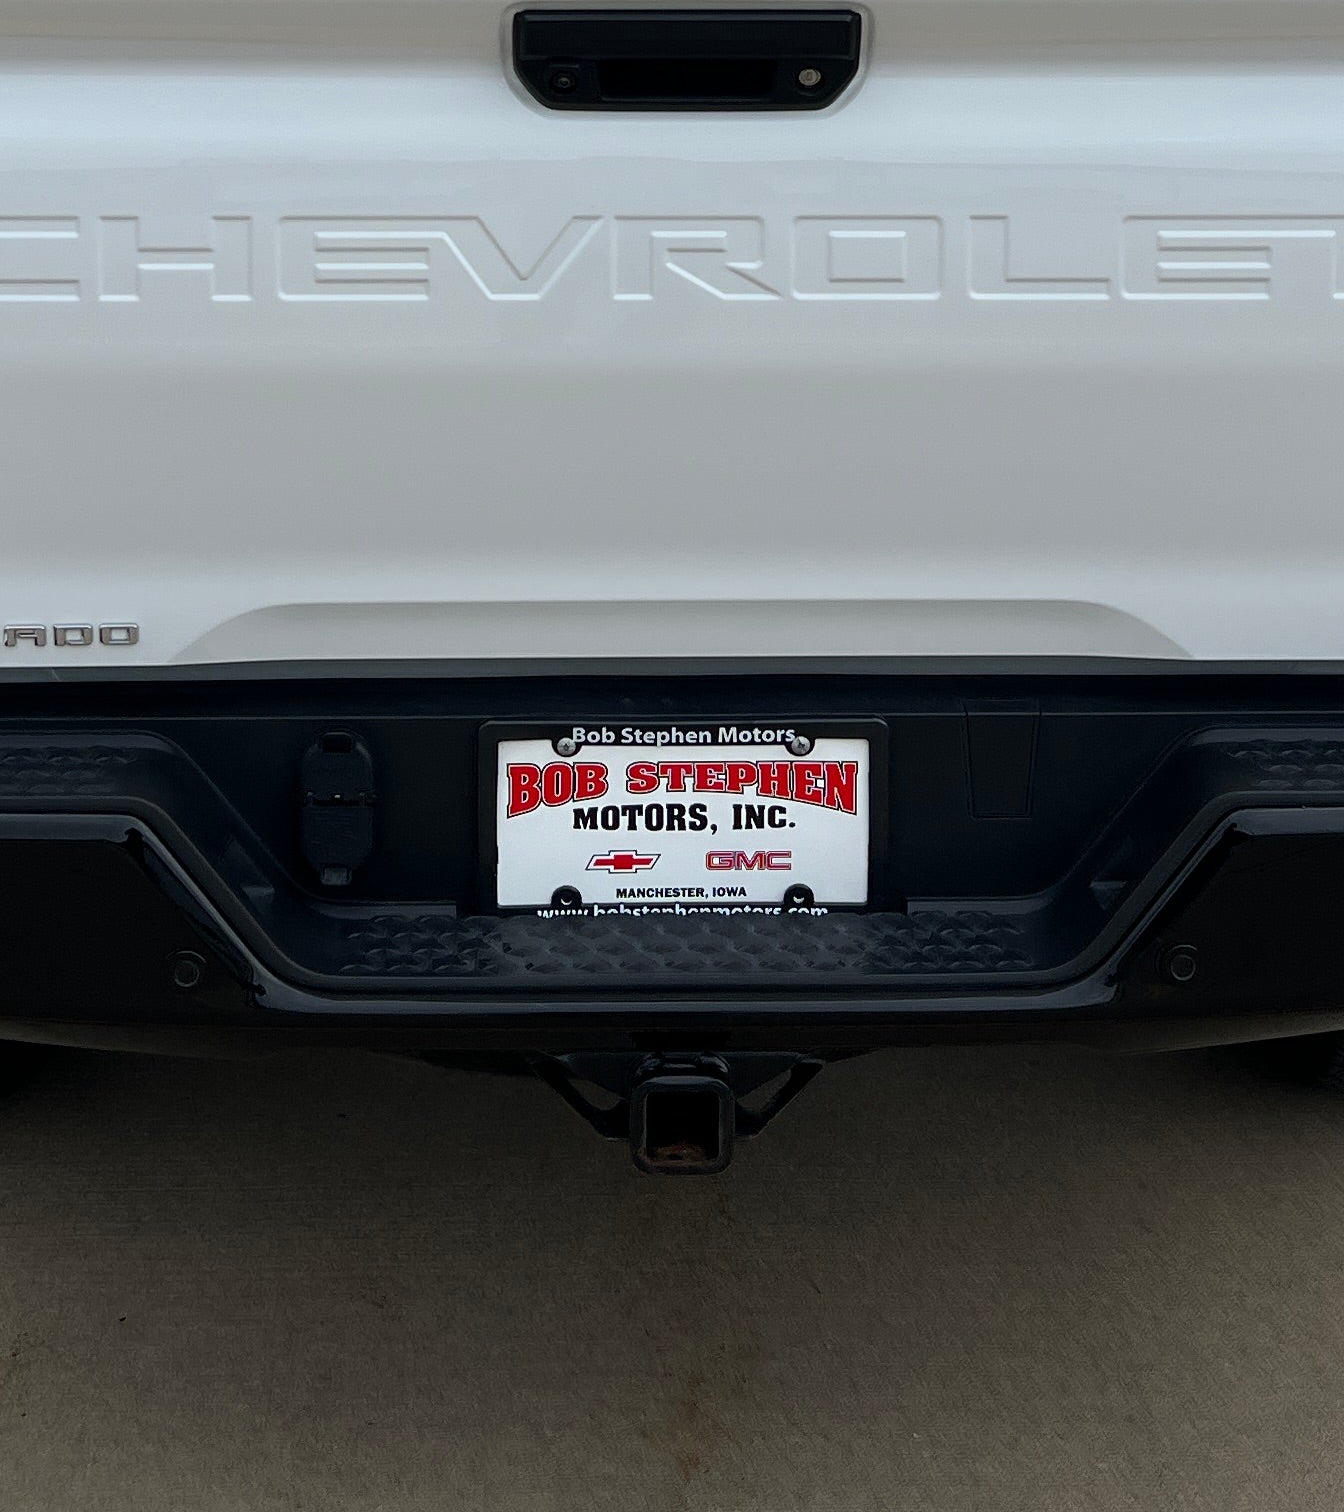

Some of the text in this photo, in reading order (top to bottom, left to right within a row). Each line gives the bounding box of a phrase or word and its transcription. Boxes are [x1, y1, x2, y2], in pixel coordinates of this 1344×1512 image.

[572, 727, 795, 747] Bob Stephen Motors
[507, 761, 858, 818] BOB STEPHEN
[573, 803, 796, 835] MOTORS, INC.
[706, 851, 792, 870] GMC
[616, 887, 747, 899] MANCHESTER, IOWA
